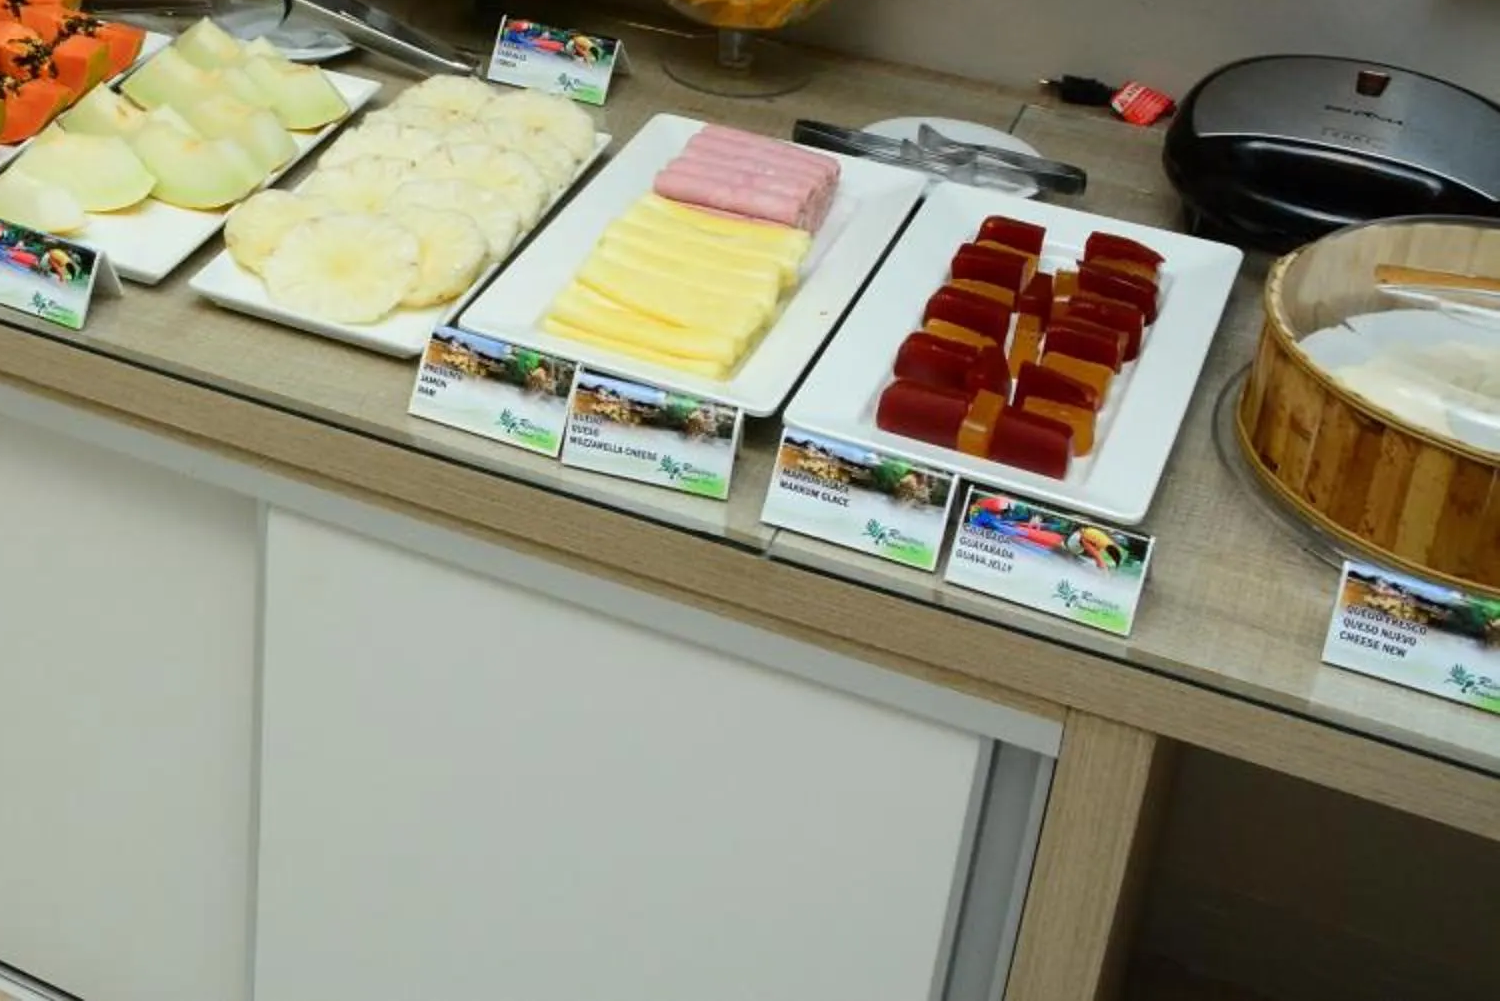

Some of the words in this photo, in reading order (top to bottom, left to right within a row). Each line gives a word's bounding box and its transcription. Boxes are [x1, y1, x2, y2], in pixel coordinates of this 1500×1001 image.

[1343, 617, 1380, 635] QUESO
[1339, 630, 1380, 650] CHEESE
[1382, 643, 1408, 658] NEW
